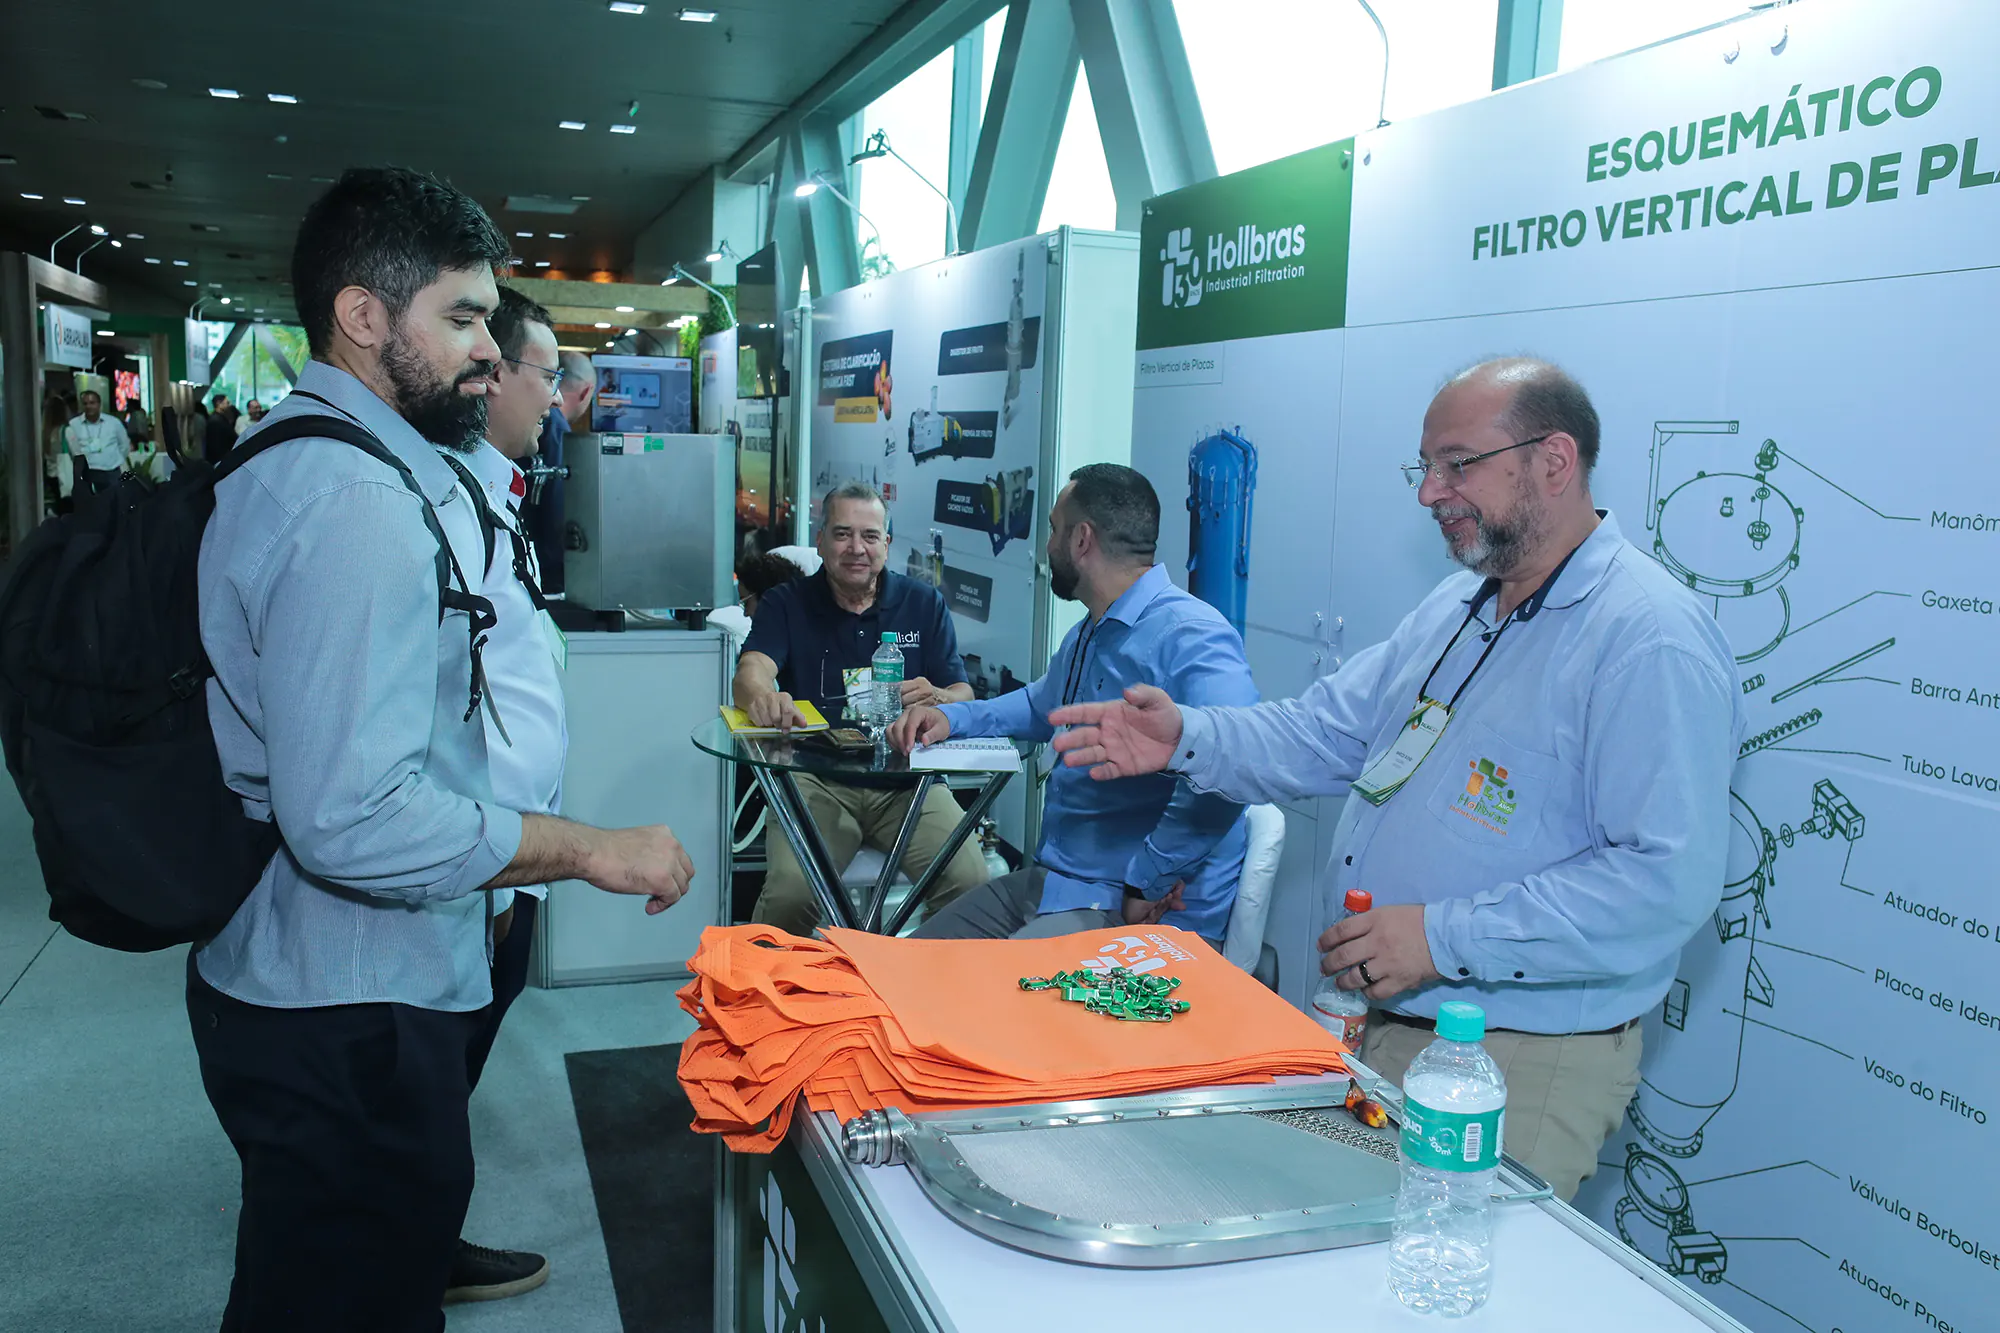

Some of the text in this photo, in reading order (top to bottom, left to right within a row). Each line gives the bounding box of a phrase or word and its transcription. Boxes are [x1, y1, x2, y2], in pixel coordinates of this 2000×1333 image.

[1586, 65, 1942, 182] ESQUEMÁTICO
[1472, 137, 2000, 260] FILTRO VERTICAL DE PL
[1207, 224, 1305, 273] Hollbras
[1206, 264, 1305, 292] Industrial Filtration
[1141, 358, 1215, 374] Filtro Vertical de Placas
[1922, 589, 1993, 614] Gaxeta
[1911, 677, 2000, 709] Barra Ant
[1902, 754, 2000, 792] Tubo Lava
[1457, 793, 1508, 825] Hollbras
[1883, 891, 1958, 928] Atuador
[1963, 918, 1989, 938] do
[1144, 933, 1190, 962] Hollbras
[1874, 968, 1924, 1001] Placa
[1929, 992, 1953, 1012] de
[1864, 1056, 1987, 1124] Vaso do Filtro
[1850, 1175, 2000, 1270] Válvula Borbolet
[1838, 1259, 1910, 1310] Atuador
